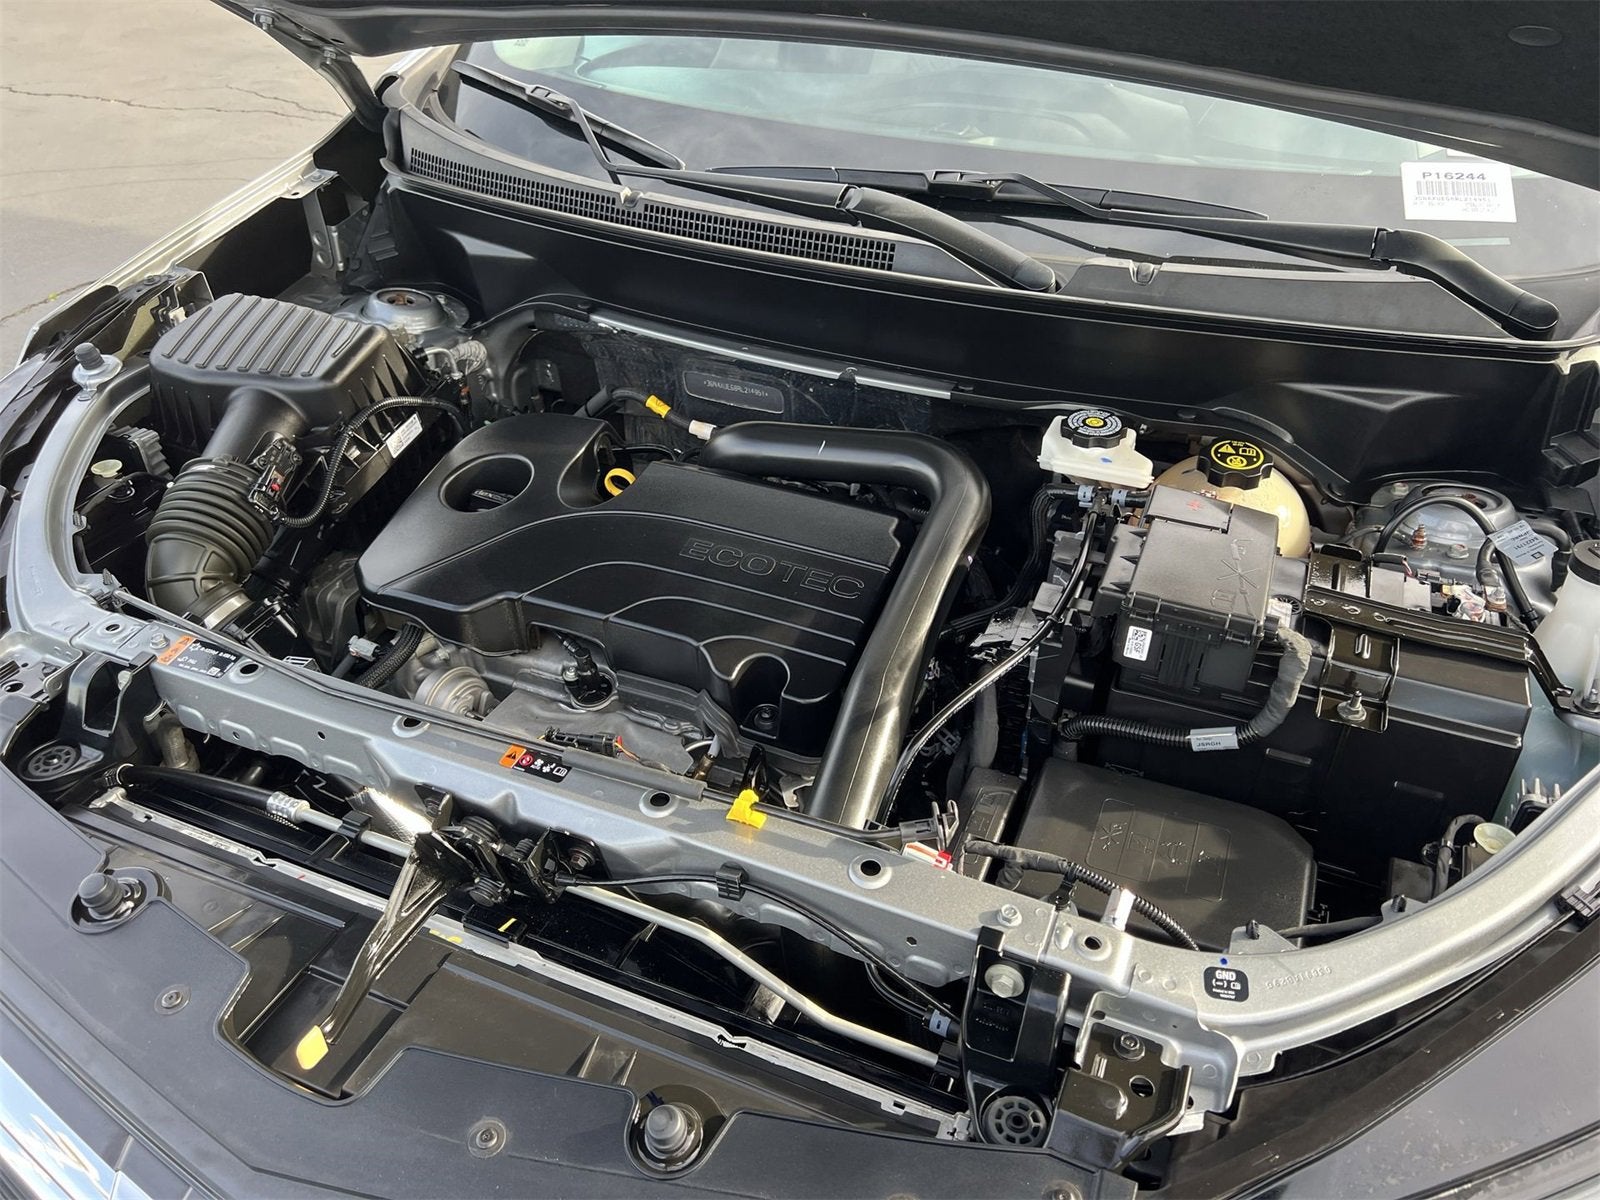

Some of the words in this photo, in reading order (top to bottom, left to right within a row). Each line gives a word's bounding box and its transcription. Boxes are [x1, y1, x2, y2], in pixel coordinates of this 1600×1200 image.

[1422, 171, 1487, 181] P16244
[679, 537, 865, 599] ECOTEC
[1215, 969, 1237, 981] GND
